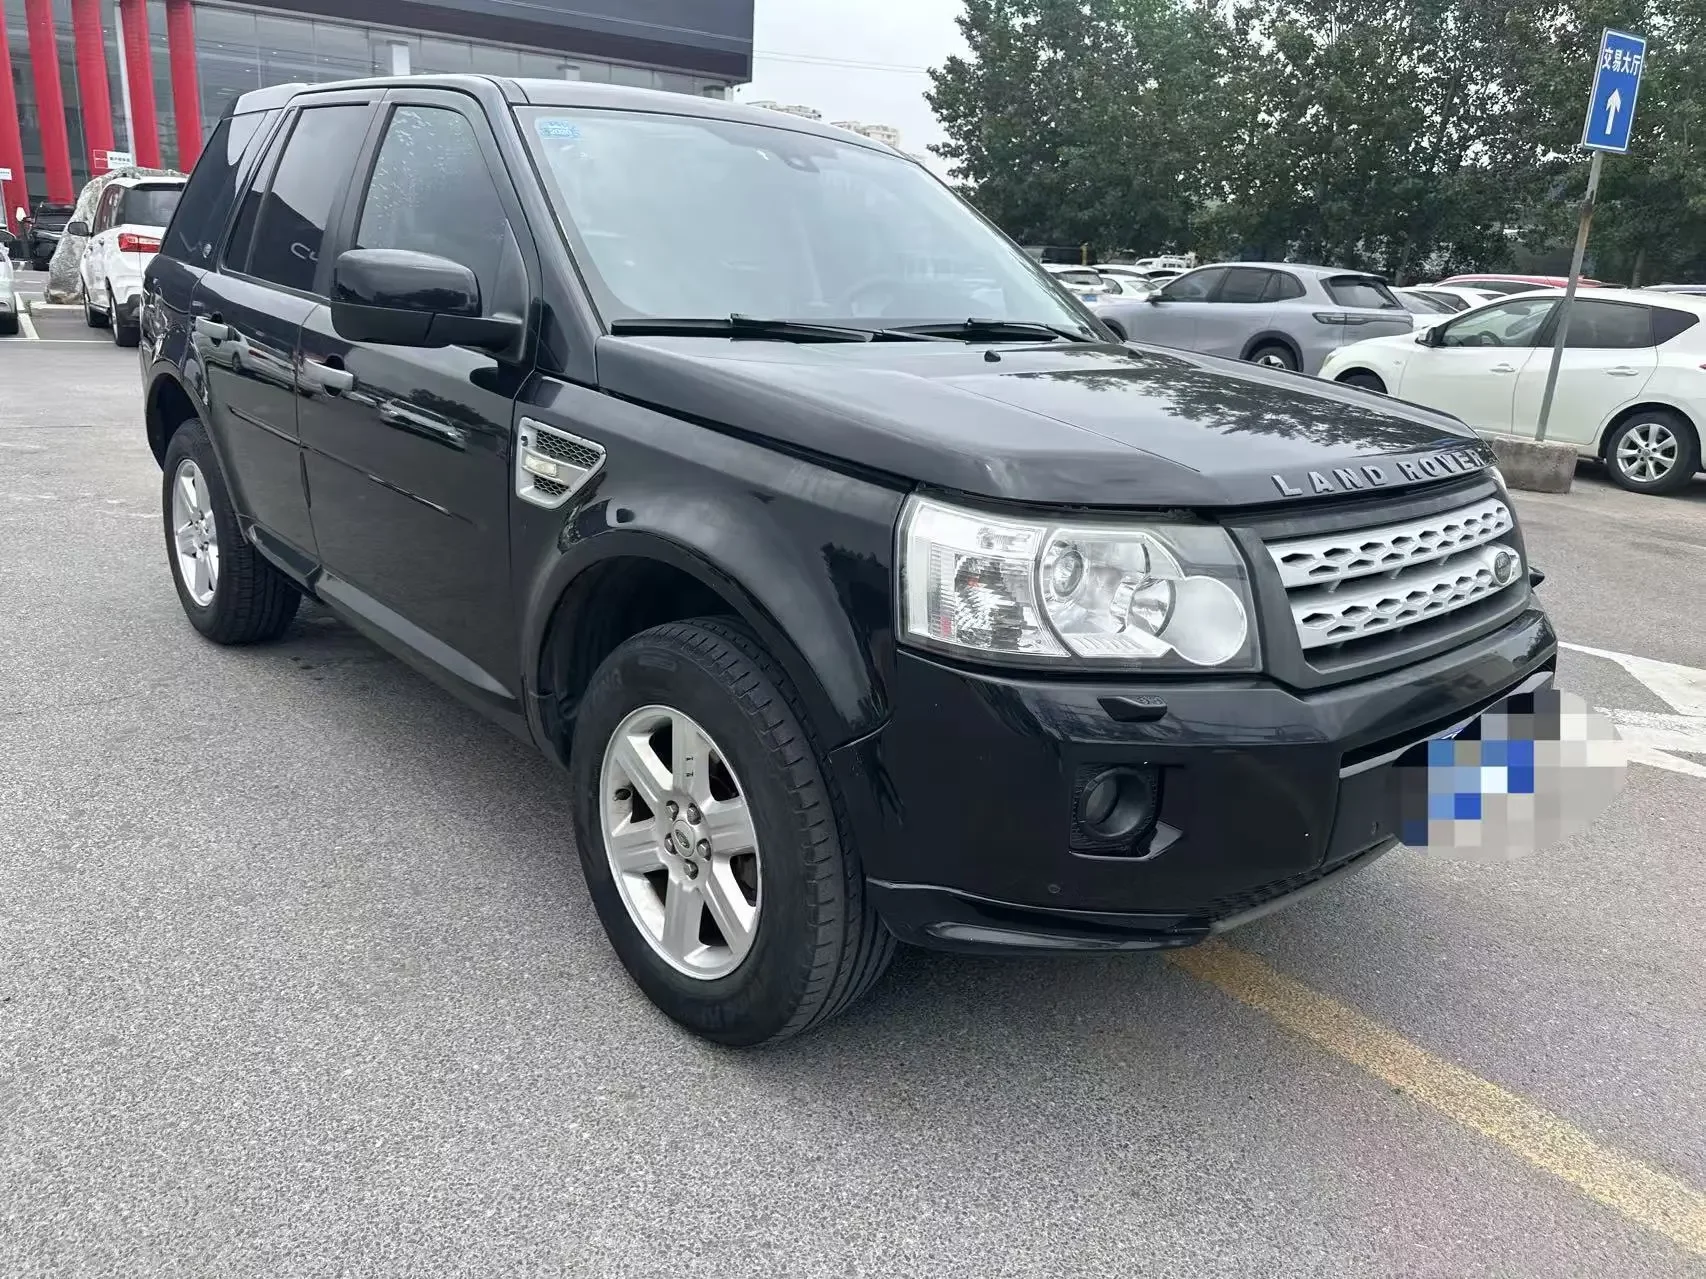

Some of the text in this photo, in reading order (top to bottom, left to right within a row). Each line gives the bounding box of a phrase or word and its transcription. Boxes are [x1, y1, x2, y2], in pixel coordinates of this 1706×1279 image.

[1601, 47, 1642, 76] 交易大厅
[1271, 449, 1486, 496] LAND ROVER
